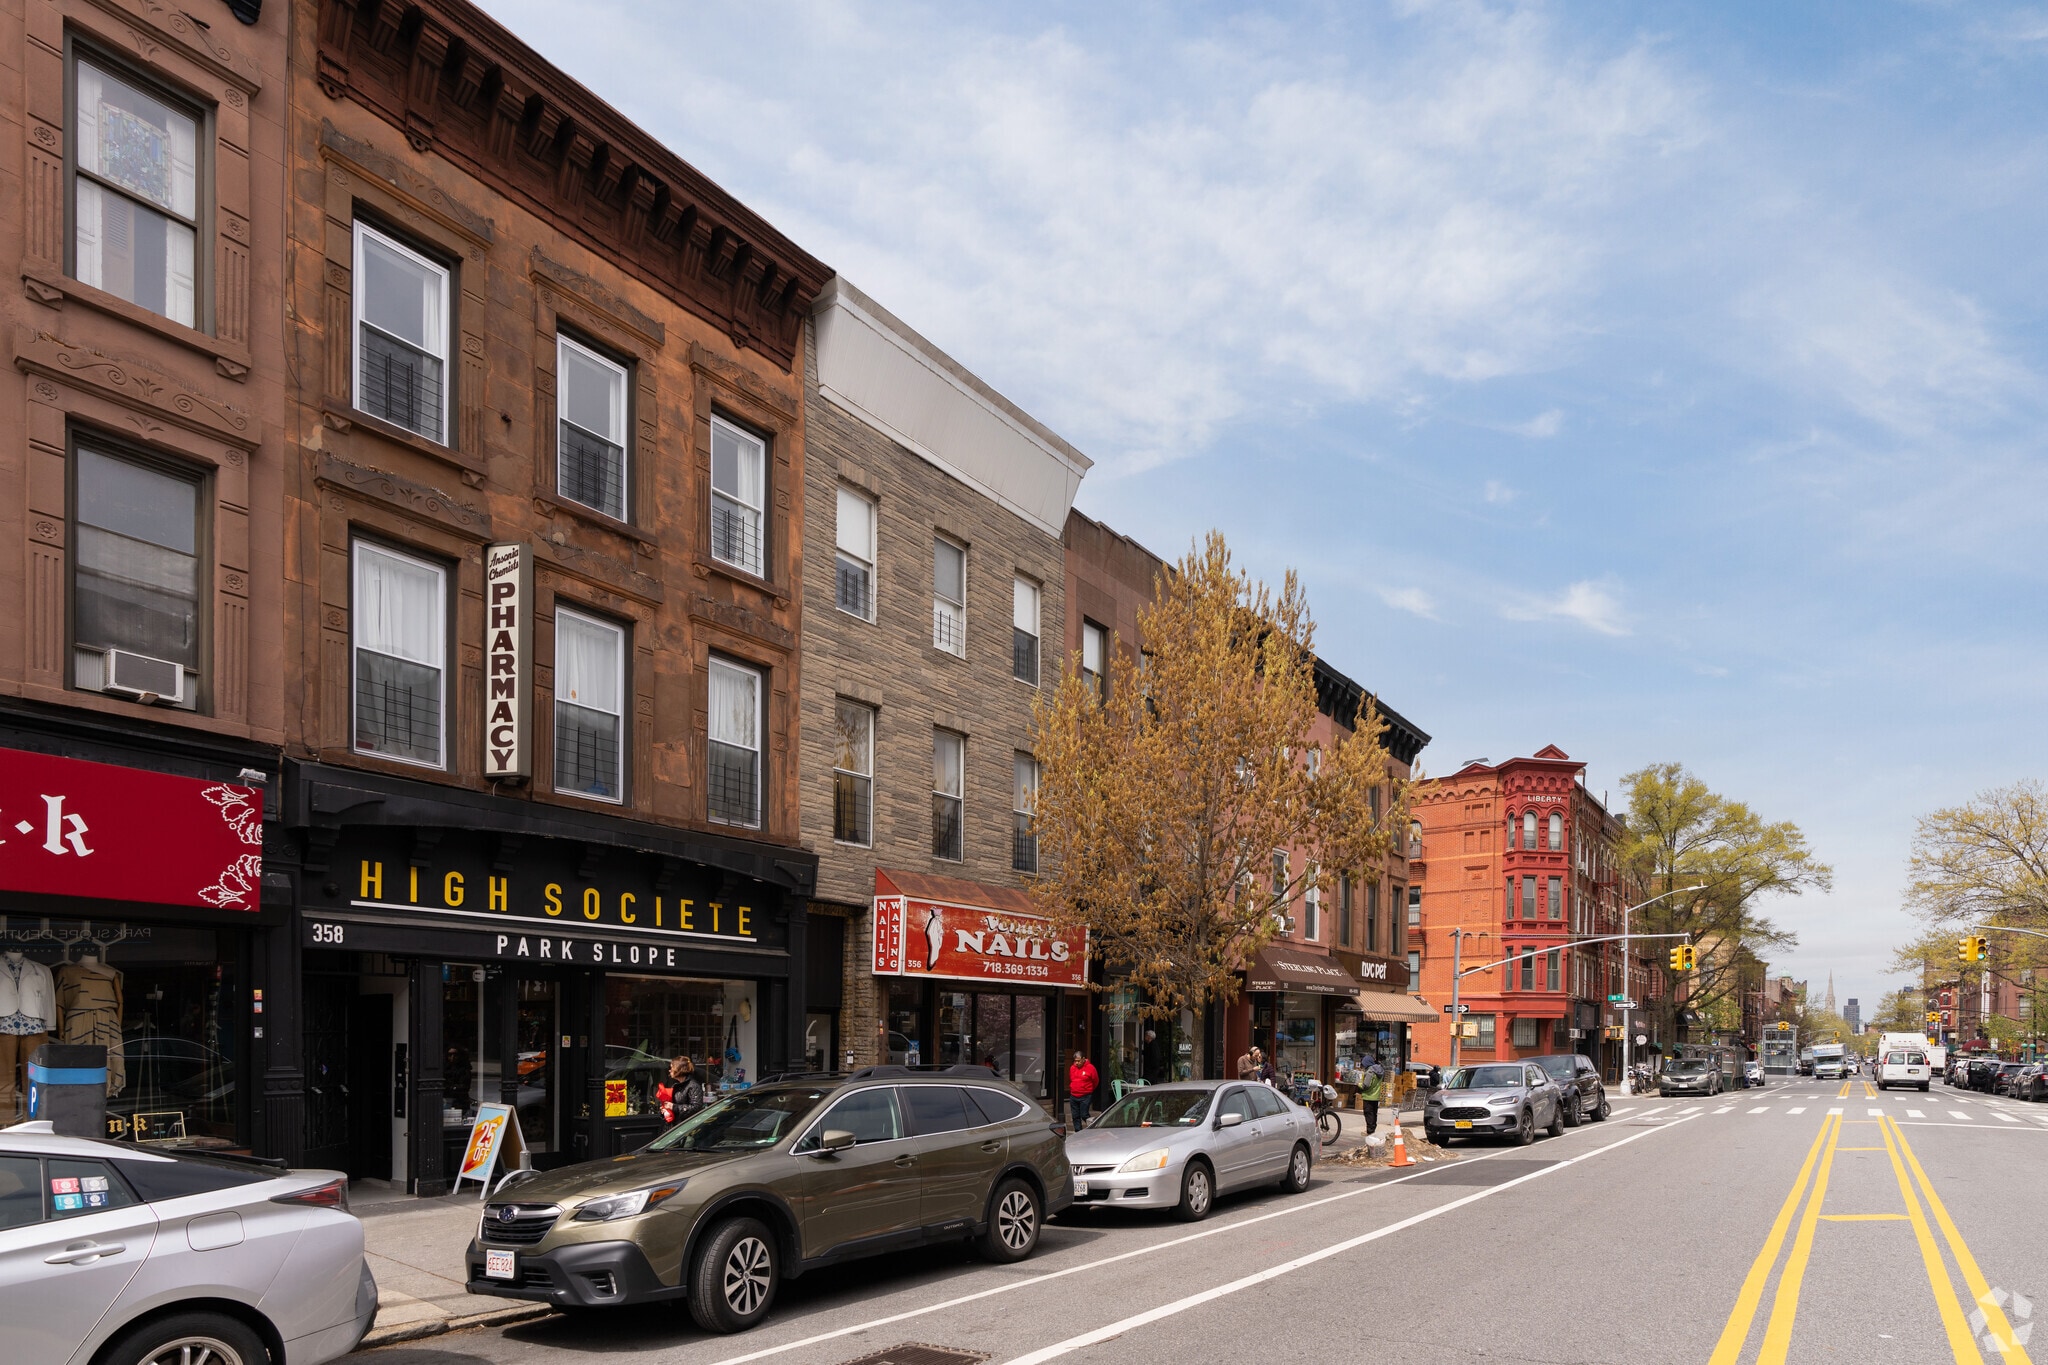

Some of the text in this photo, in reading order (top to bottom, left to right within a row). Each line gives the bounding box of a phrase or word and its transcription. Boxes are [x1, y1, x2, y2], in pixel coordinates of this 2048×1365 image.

[489, 547, 519, 568] Ansonia
[489, 559, 519, 581] Chemists
[490, 582, 516, 771] PHARMACY
[1527, 795, 1562, 803] LIBERTY
[360, 859, 751, 936] HIGH SOCIETE
[312, 923, 344, 944] 358
[878, 901, 887, 967] NAILS
[889, 901, 900, 968] WAXING
[496, 934, 676, 967] PARK SLOPE
[954, 929, 1069, 962] NAILS
[907, 960, 922, 968] 356
[983, 961, 1049, 977] 718.369.1334
[1277, 960, 1342, 977] STERLING PLACE
[1071, 973, 1082, 981] 356
[476, 1121, 498, 1148] 25
[472, 1147, 491, 1162] OFF
